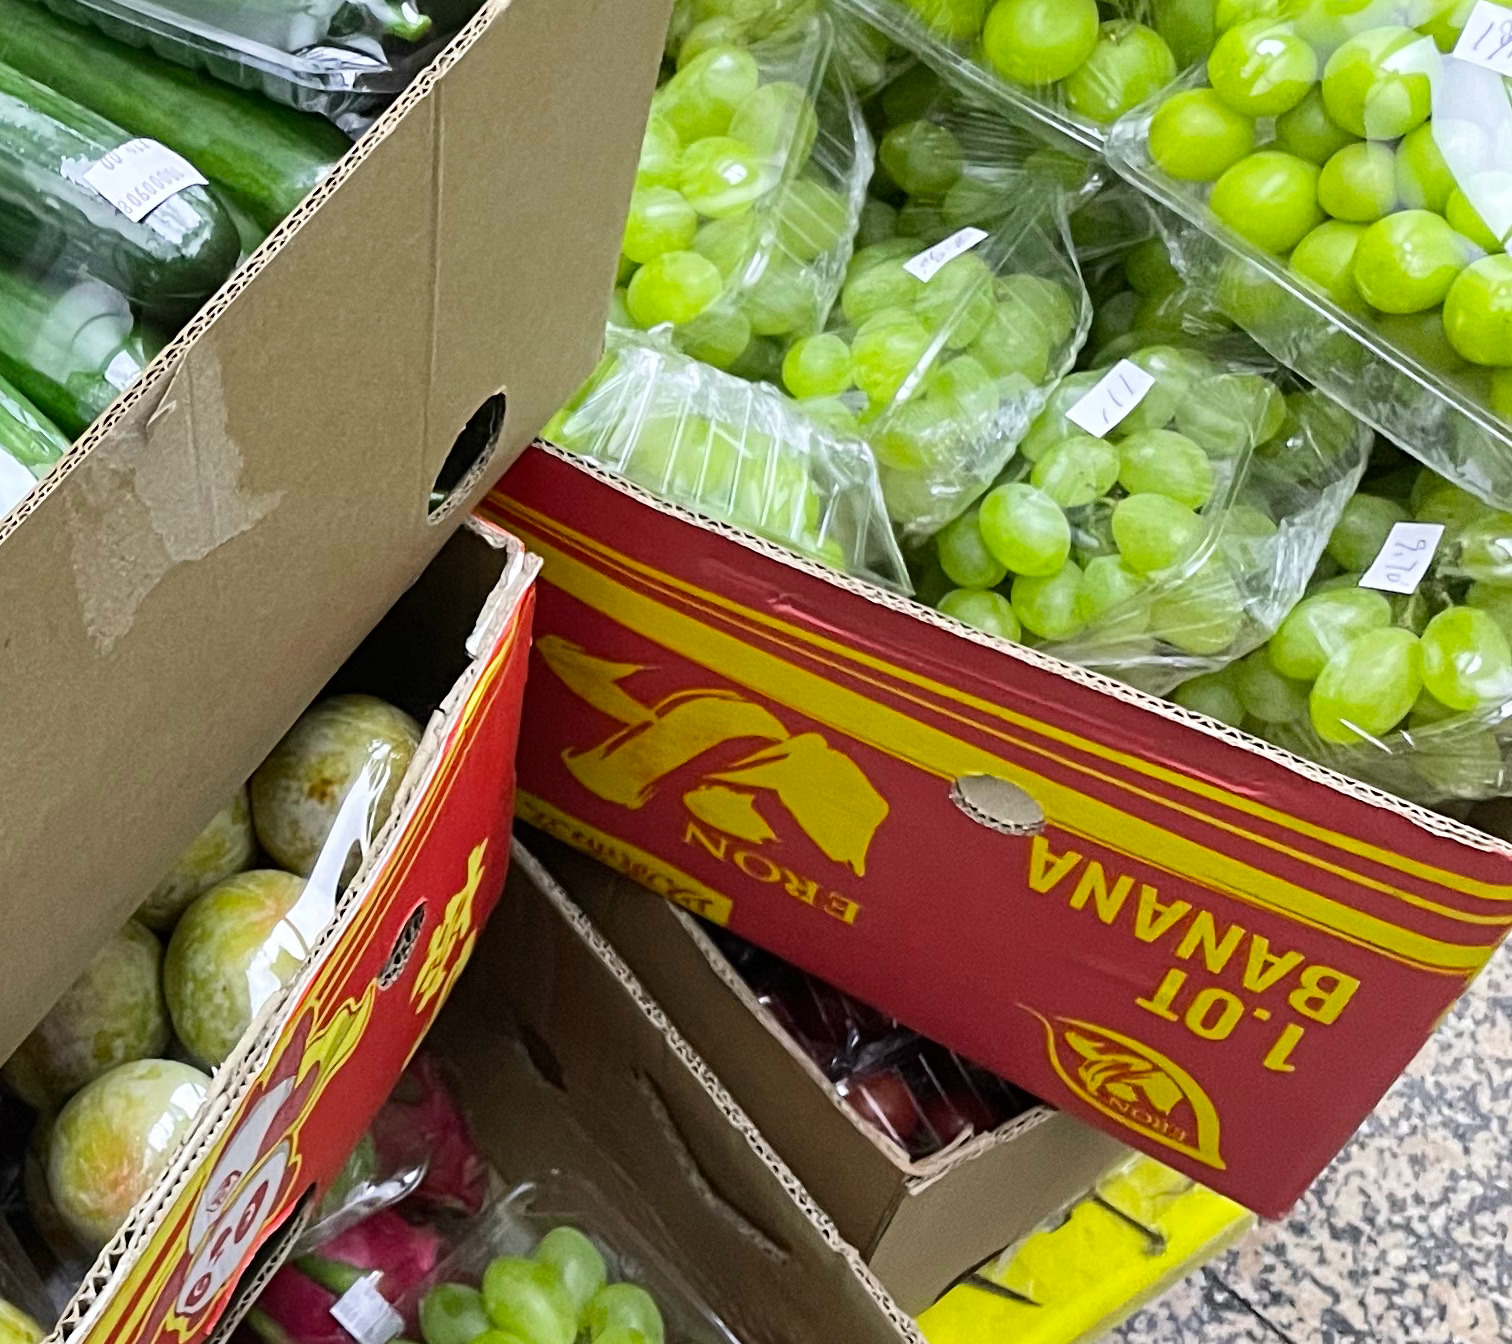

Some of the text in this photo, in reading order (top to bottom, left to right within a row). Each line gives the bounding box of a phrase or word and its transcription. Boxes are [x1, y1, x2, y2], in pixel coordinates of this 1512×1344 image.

[683, 821, 863, 927] ERON
[1028, 836, 1362, 1028] BANANA
[1136, 963, 1305, 1074] 1.0T
